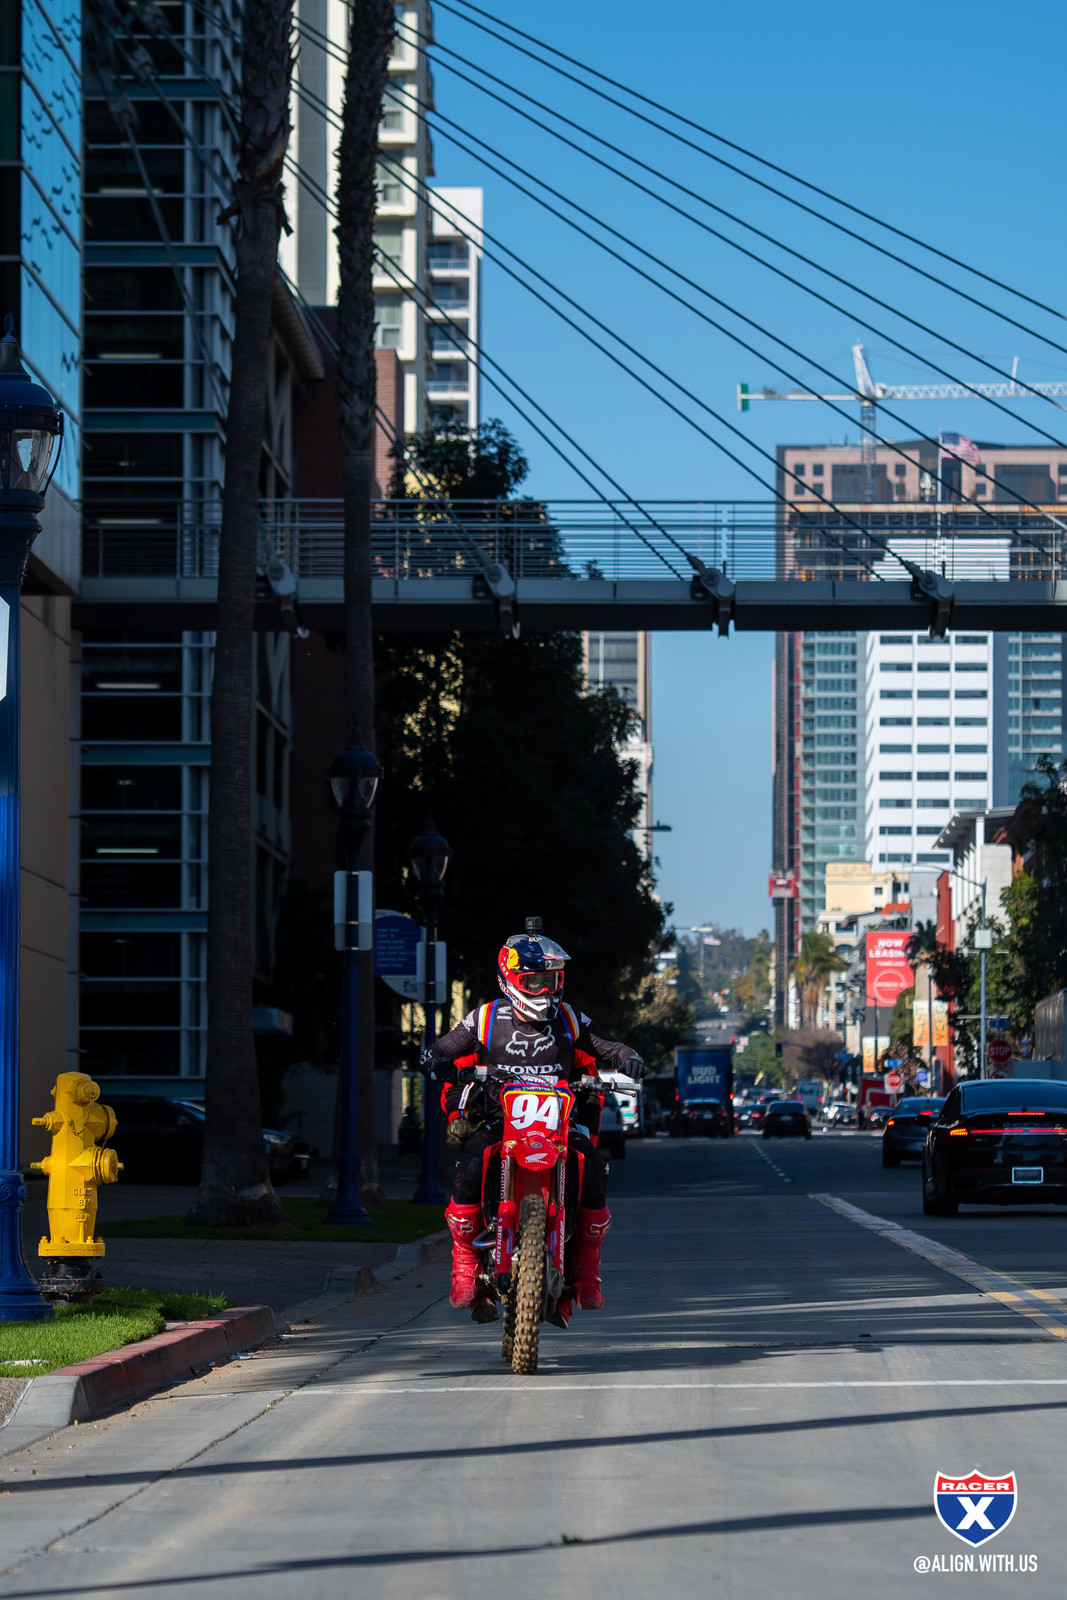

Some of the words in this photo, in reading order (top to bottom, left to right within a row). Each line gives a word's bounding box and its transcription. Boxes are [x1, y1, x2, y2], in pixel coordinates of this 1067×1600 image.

[877, 938, 903, 948] NOW
[989, 1046, 1011, 1057] STOP
[496, 1063, 564, 1075] HONDA
[691, 1066, 717, 1076] BUD
[687, 1075, 721, 1085] LIGHT
[510, 1094, 564, 1130] 94
